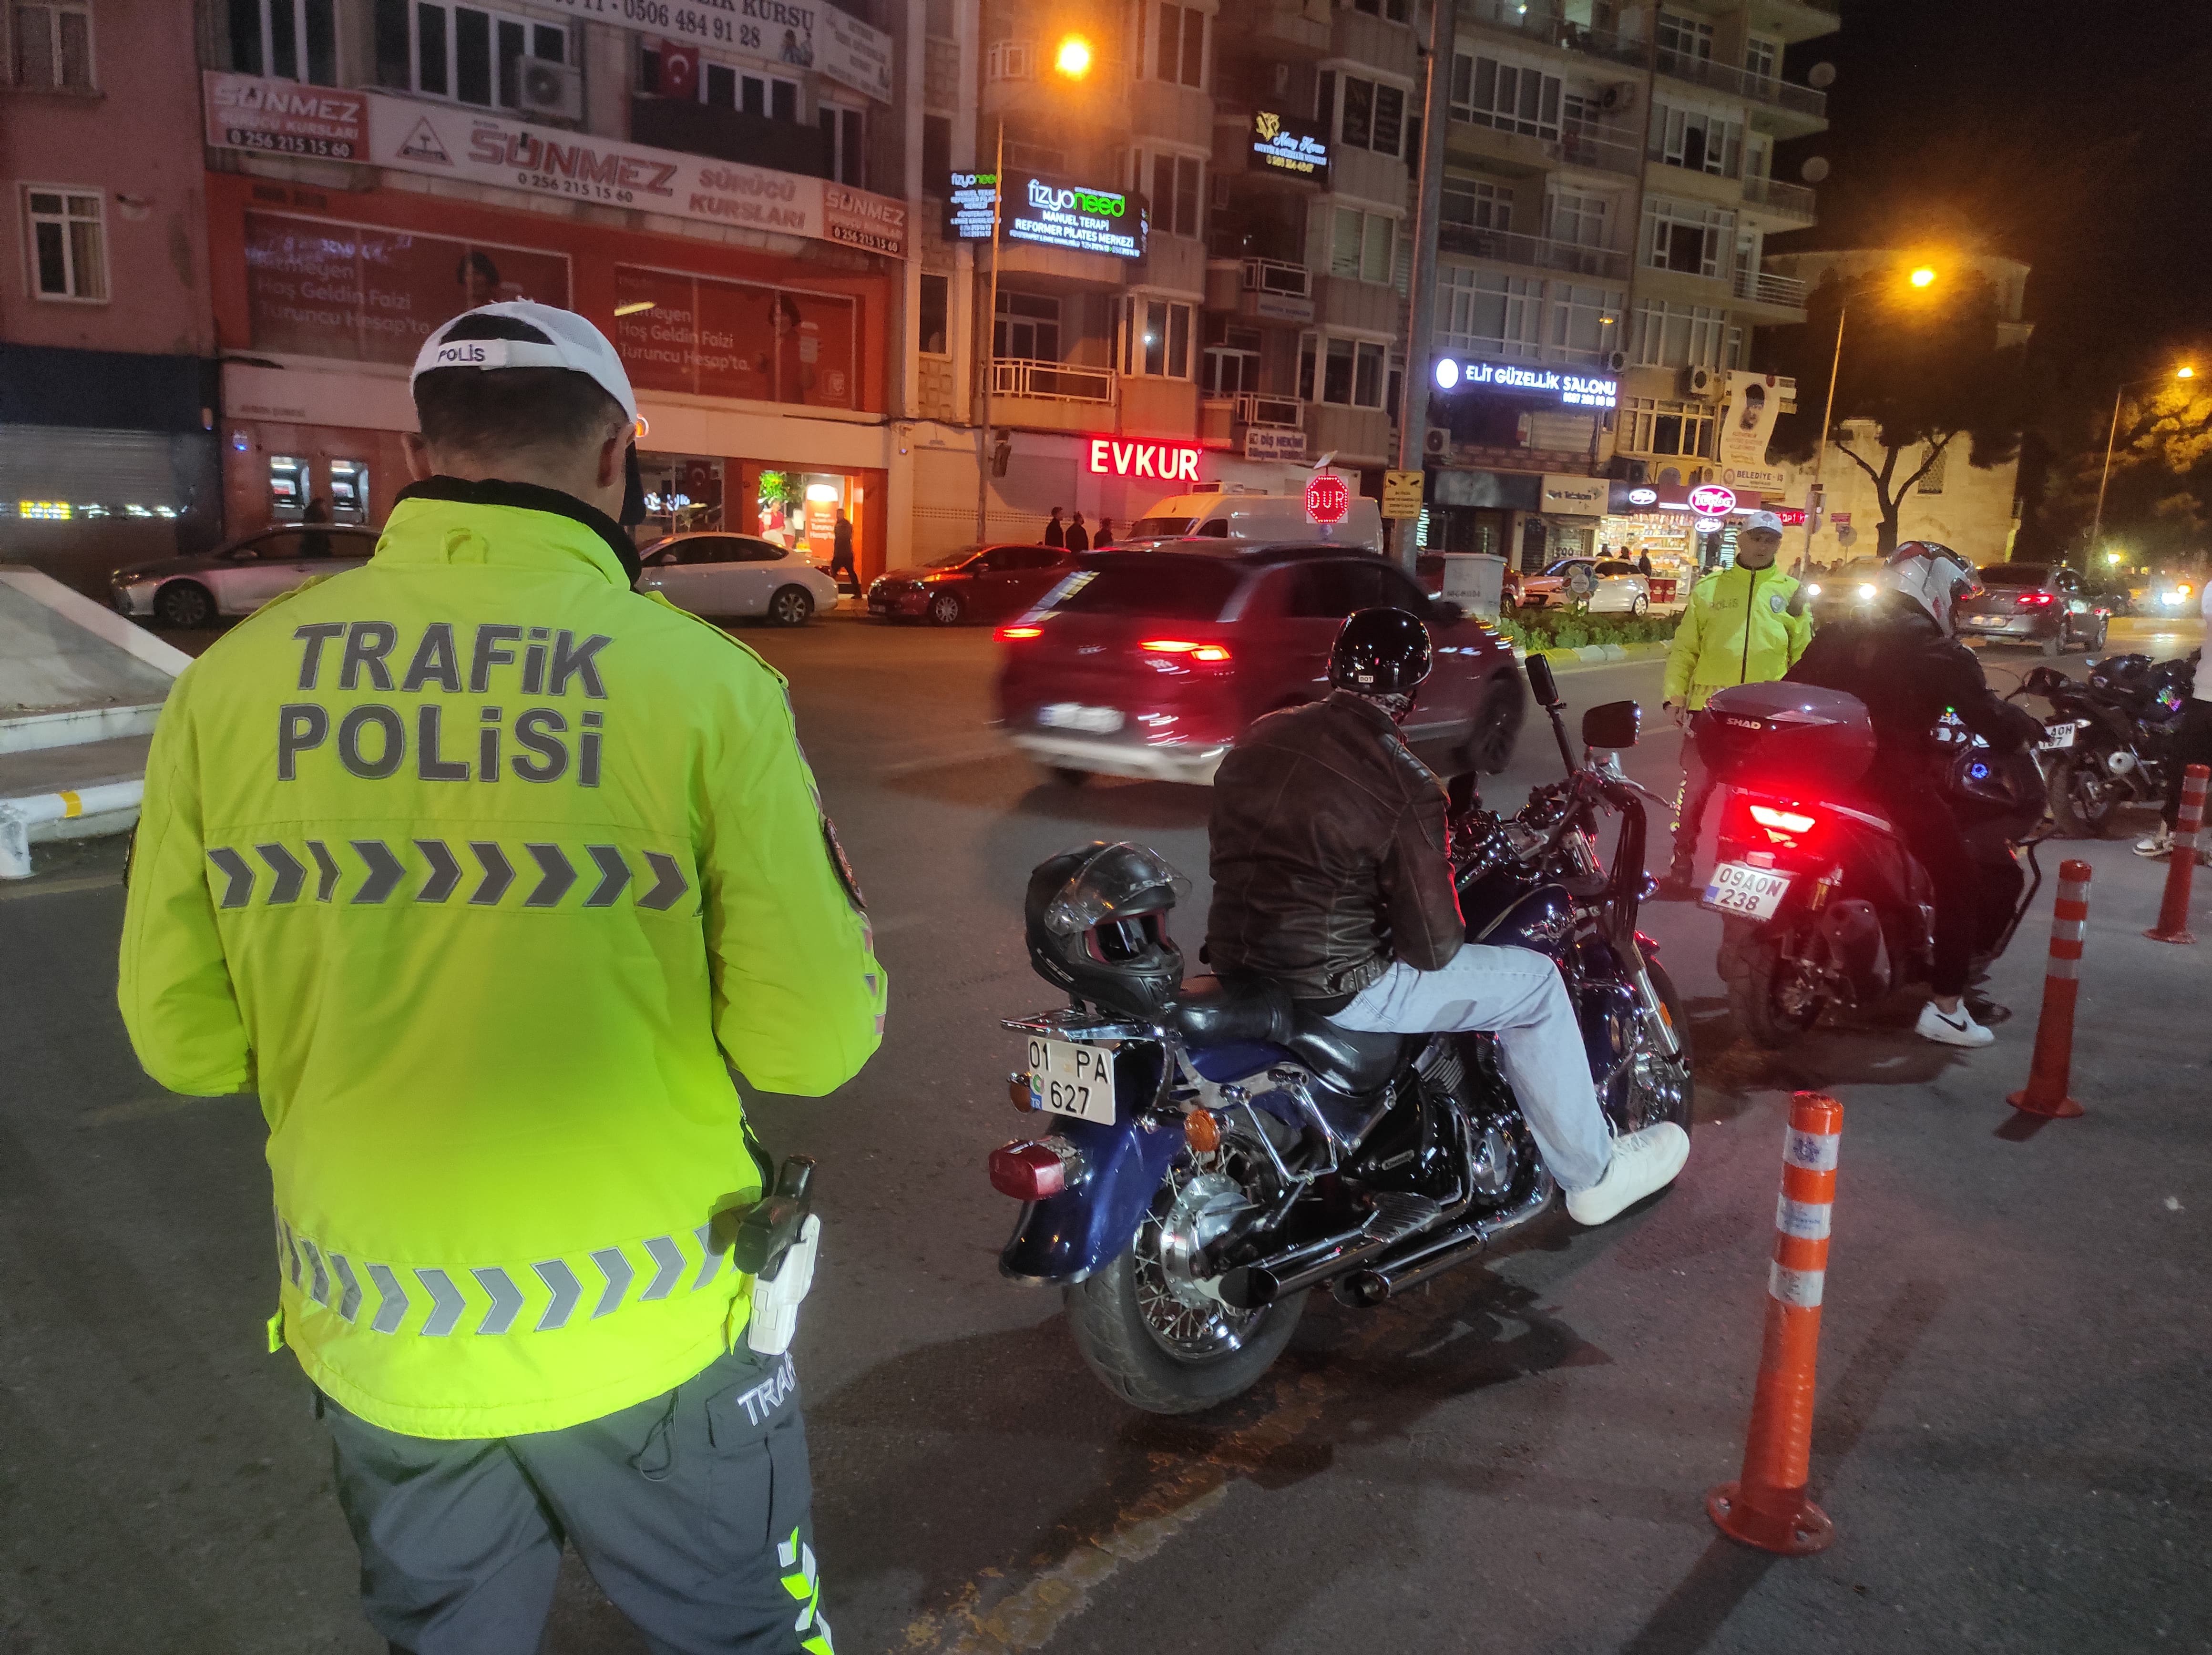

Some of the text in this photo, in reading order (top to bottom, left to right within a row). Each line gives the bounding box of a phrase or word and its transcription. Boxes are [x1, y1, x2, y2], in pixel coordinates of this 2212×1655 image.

[676, 9, 707, 37] 484
[713, 18, 733, 42] 91
[739, 24, 761, 49] 28
[518, 172, 527, 184] 0
[532, 174, 559, 191] 256
[563, 180, 590, 195] 215
[596, 187, 611, 199] 15
[1028, 178, 1125, 217] fizyoneed
[688, 193, 806, 229] KURSLARI
[1043, 210, 1079, 227] MANUEL
[1015, 217, 1063, 237] REFORMER
[1562, 376, 1617, 396] SALONU
[1091, 439, 1199, 482] EVKUR
[1311, 490, 1344, 509] DUR
[1727, 718, 1761, 730] SHAD
[1720, 889, 1760, 911] 238
[1030, 1041, 1111, 1085] 01 PA
[1031, 1097, 1042, 1109] TR
[1051, 1081, 1091, 1115] 627
